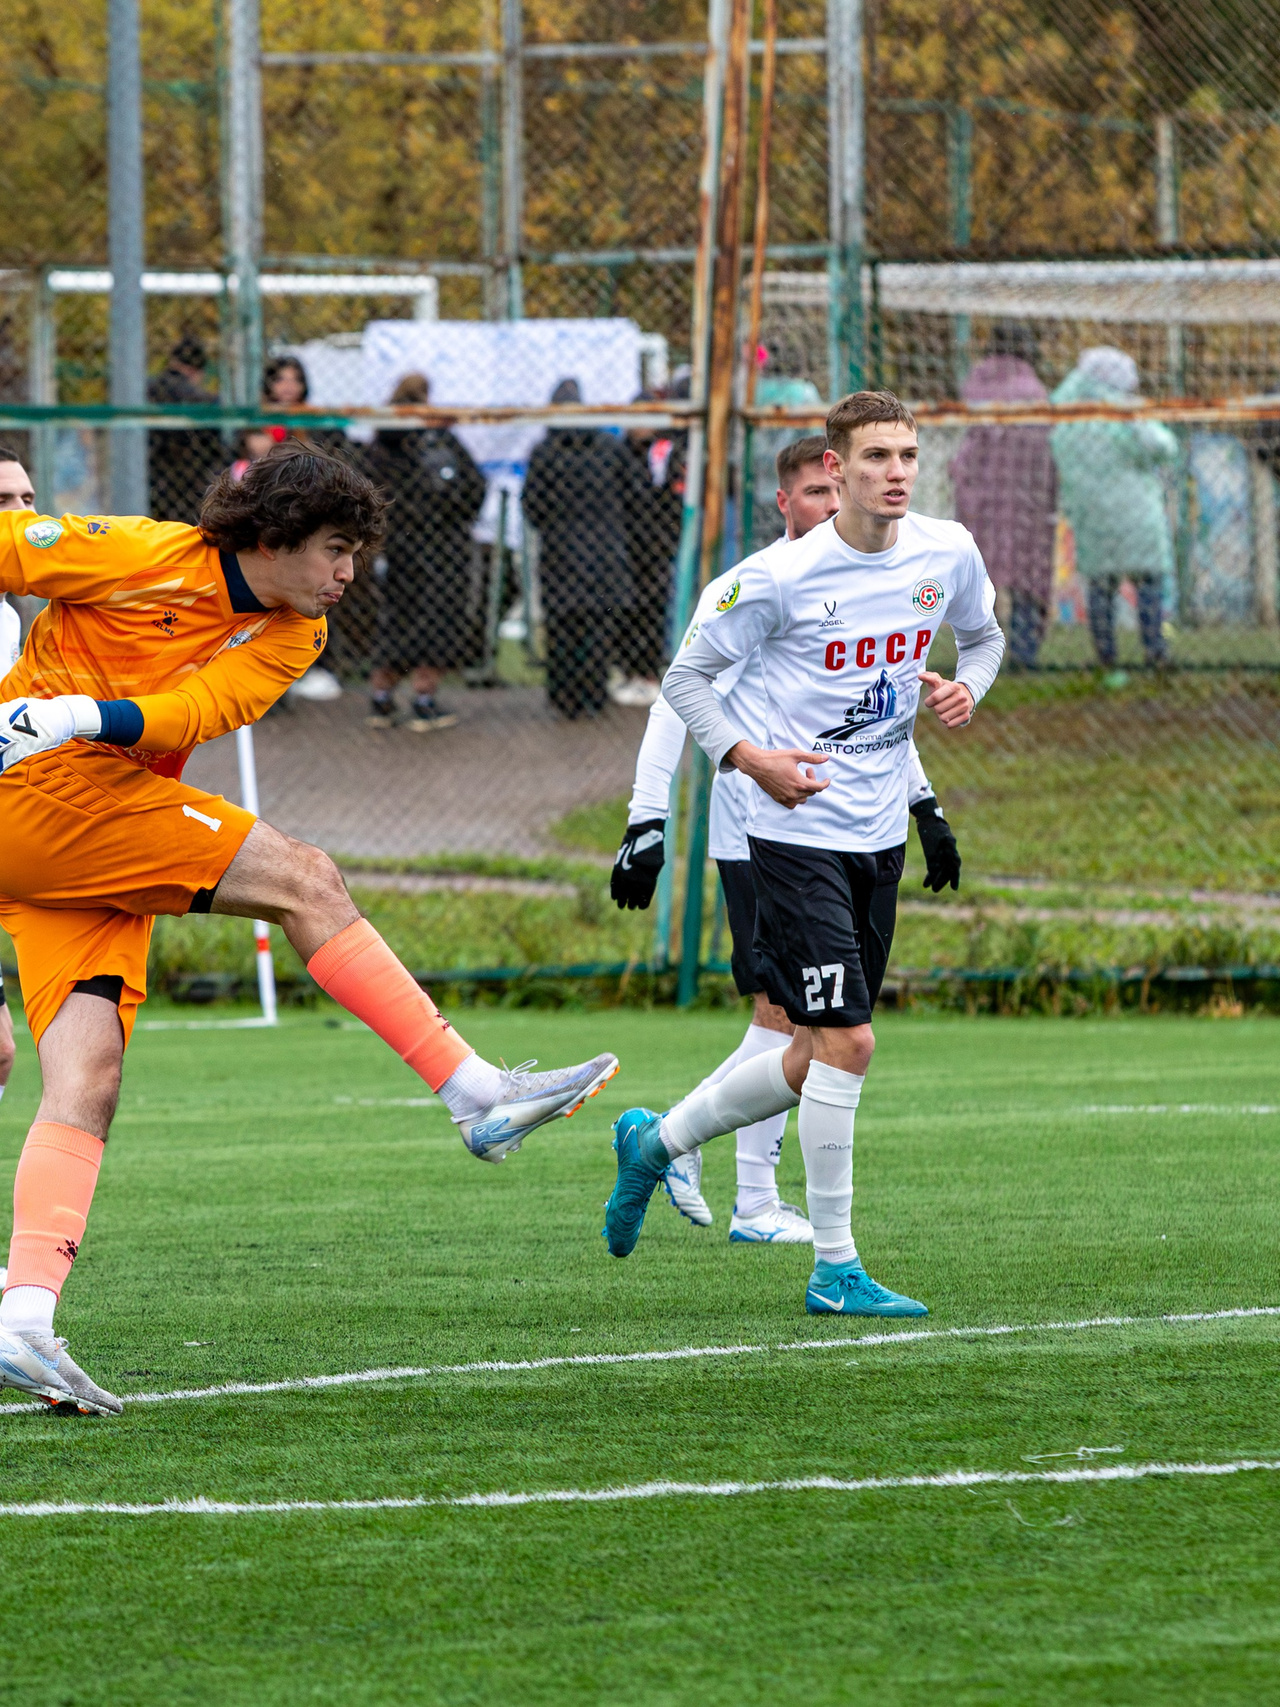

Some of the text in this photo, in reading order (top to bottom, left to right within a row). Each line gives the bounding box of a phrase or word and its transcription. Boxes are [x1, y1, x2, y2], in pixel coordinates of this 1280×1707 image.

[151, 620, 175, 637] KELME
[824, 629, 932, 671] СССР
[182, 803, 223, 833] 1
[802, 963, 845, 1012] 27
